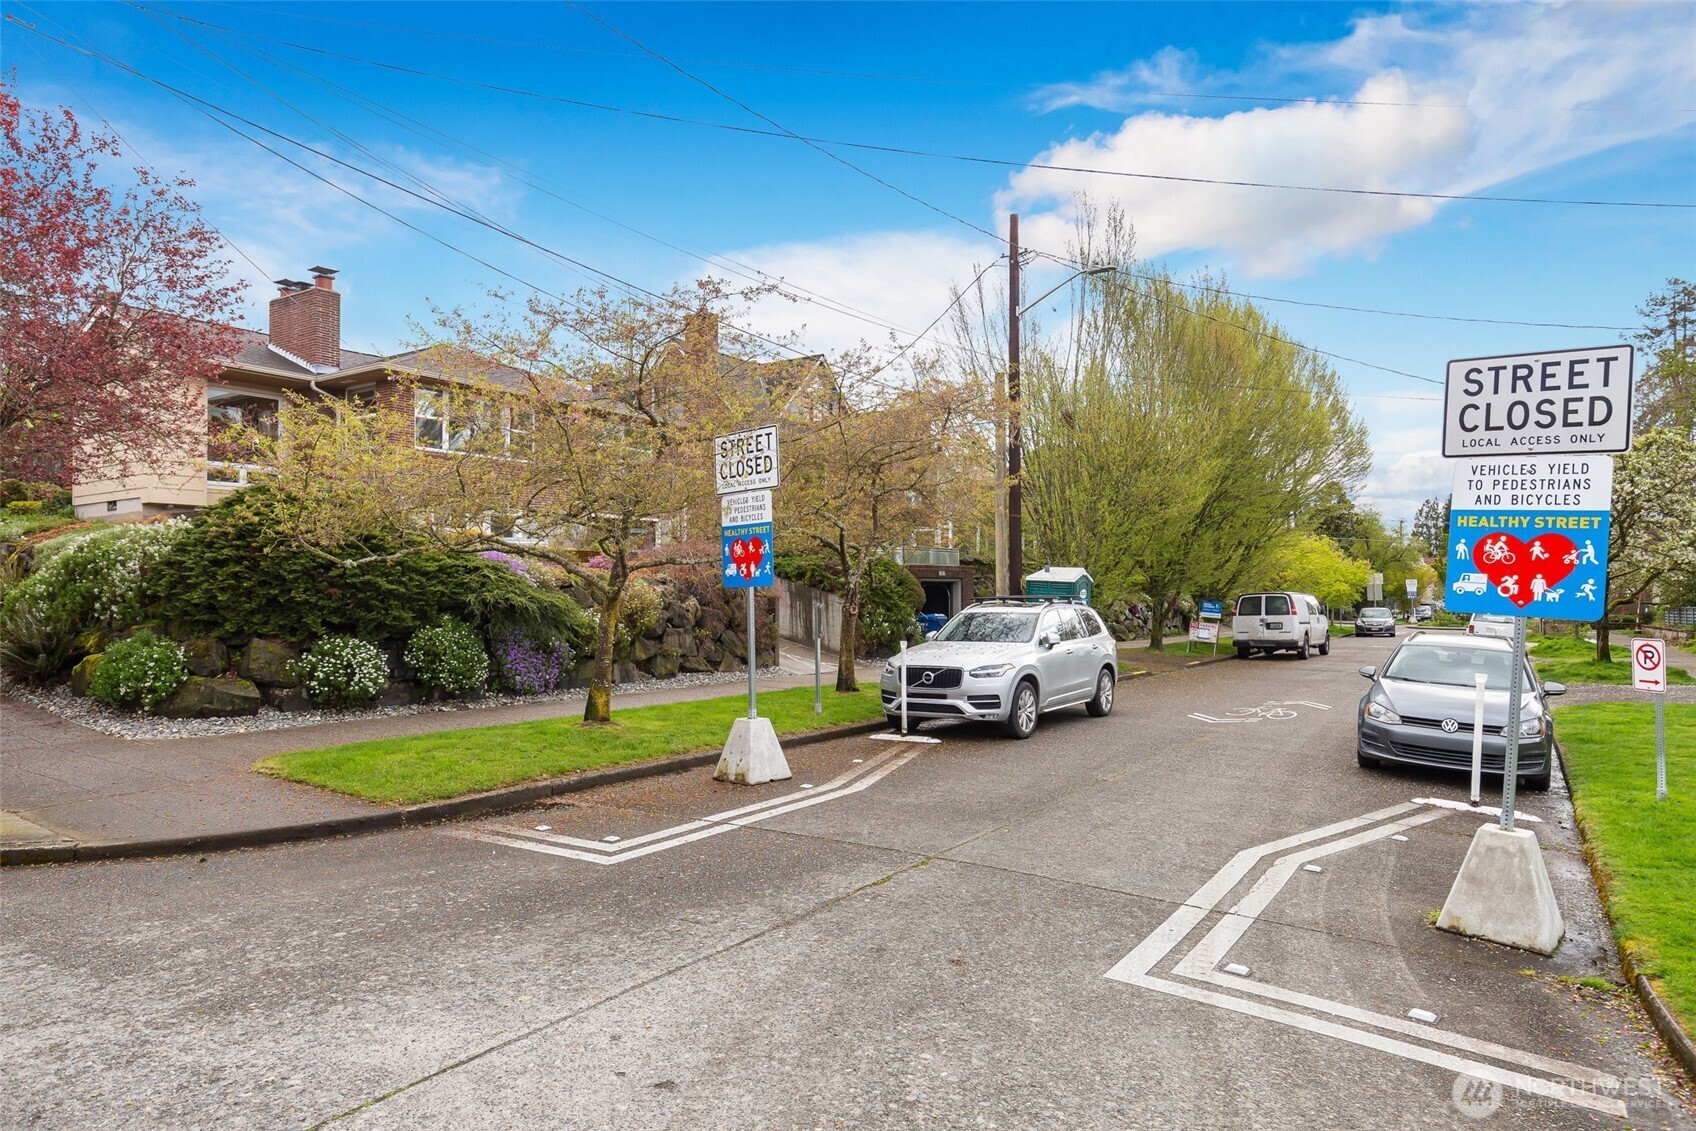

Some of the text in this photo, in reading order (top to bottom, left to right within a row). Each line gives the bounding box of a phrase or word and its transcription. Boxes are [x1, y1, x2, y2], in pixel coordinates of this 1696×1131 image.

[1463, 356, 1618, 396] STREET
[1459, 395, 1613, 432] CLOSED
[721, 432, 772, 458] STREET
[1462, 433, 1606, 448] LOCAL ACCESS ONLY
[720, 455, 773, 480] CLOSED
[1471, 463, 1589, 475] VEHICLES YIELD
[1468, 478, 1591, 491] TO PEDESTRIANS
[727, 495, 765, 506] VEHICLES YIELD
[1475, 494, 1581, 506] AND BICYCLES
[734, 503, 766, 513] PEDESTRIANS
[741, 513, 763, 522] BICYCLES
[1457, 515, 1602, 529] HEALTHY STREET
[724, 526, 770, 537] HEALTHY STREET
